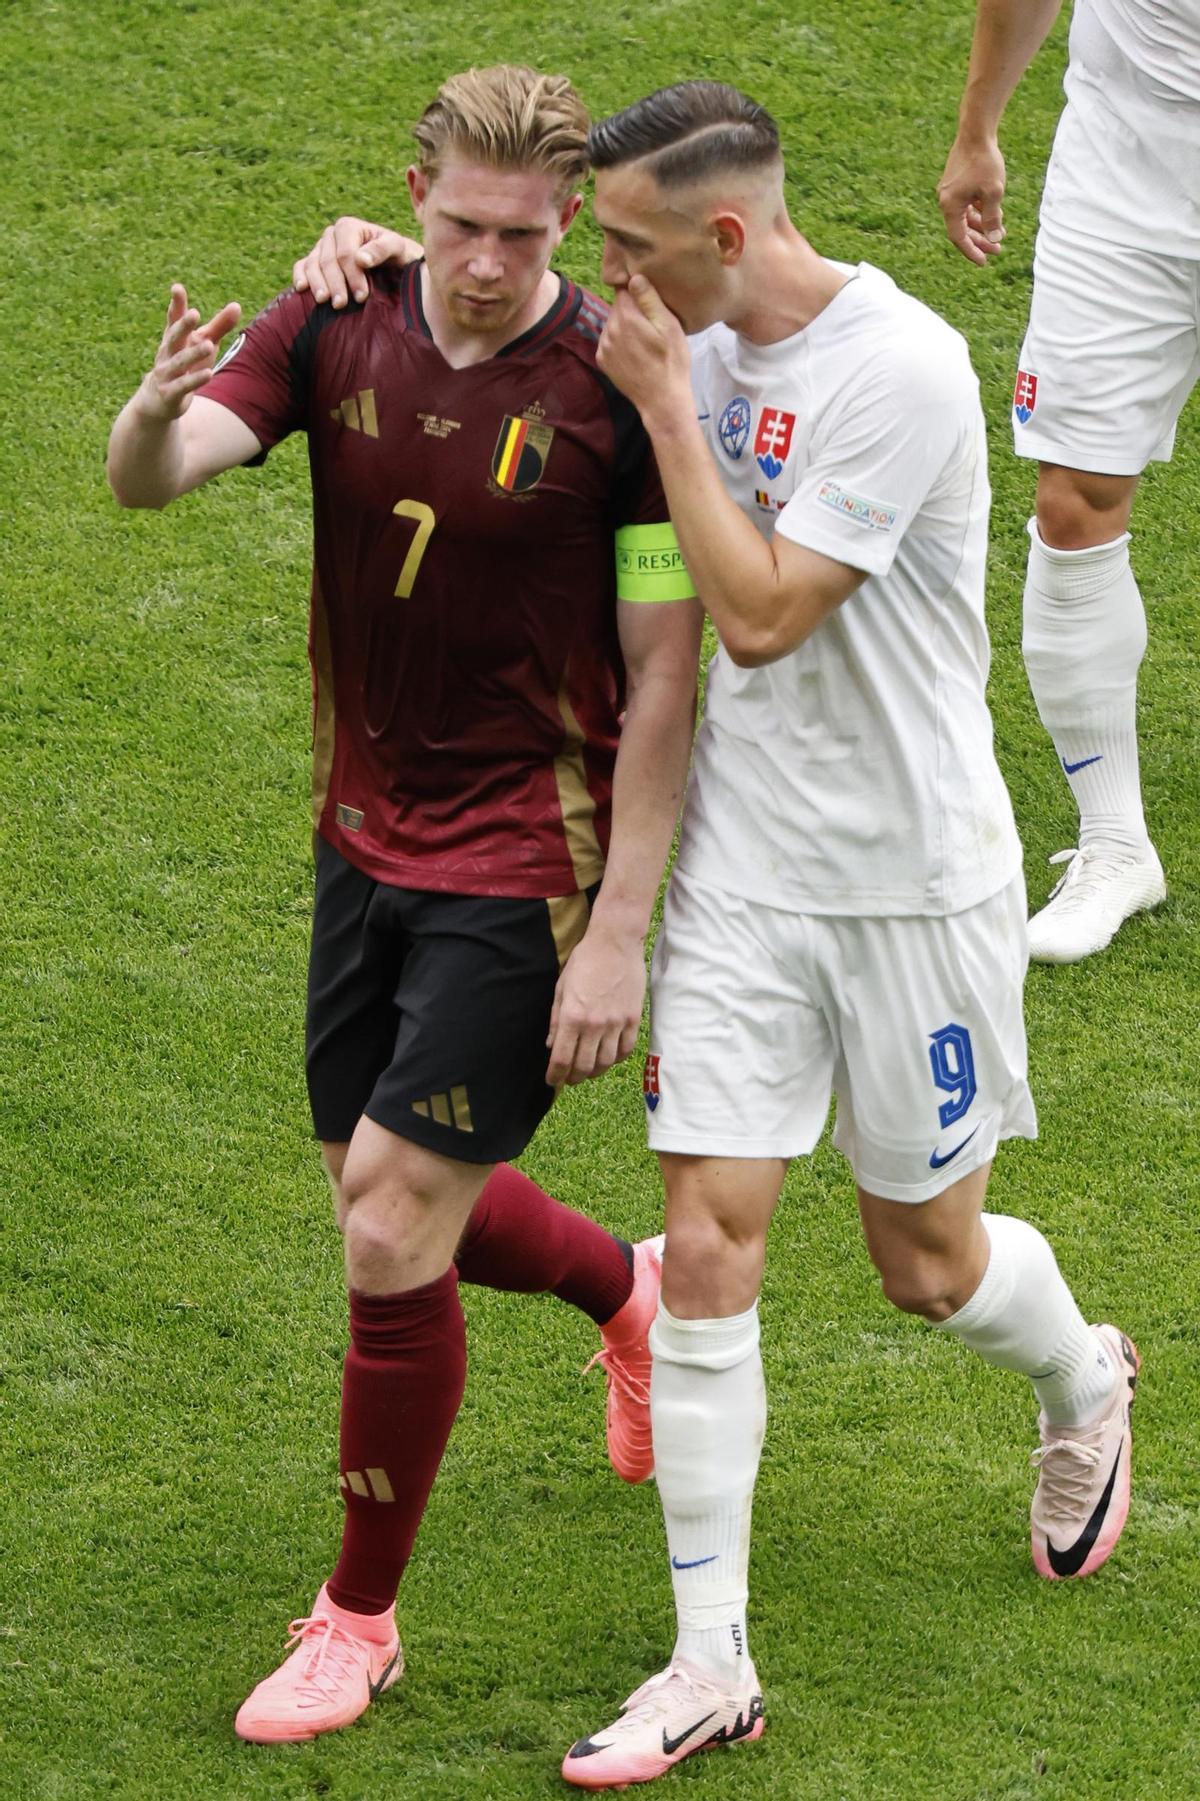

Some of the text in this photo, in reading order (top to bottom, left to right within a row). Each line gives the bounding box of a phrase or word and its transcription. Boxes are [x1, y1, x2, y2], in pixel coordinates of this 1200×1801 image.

[819, 487, 895, 525] FOUNDATION
[392, 498, 436, 599] 7
[638, 552, 685, 569] RESP
[928, 1022, 977, 1130] 9
